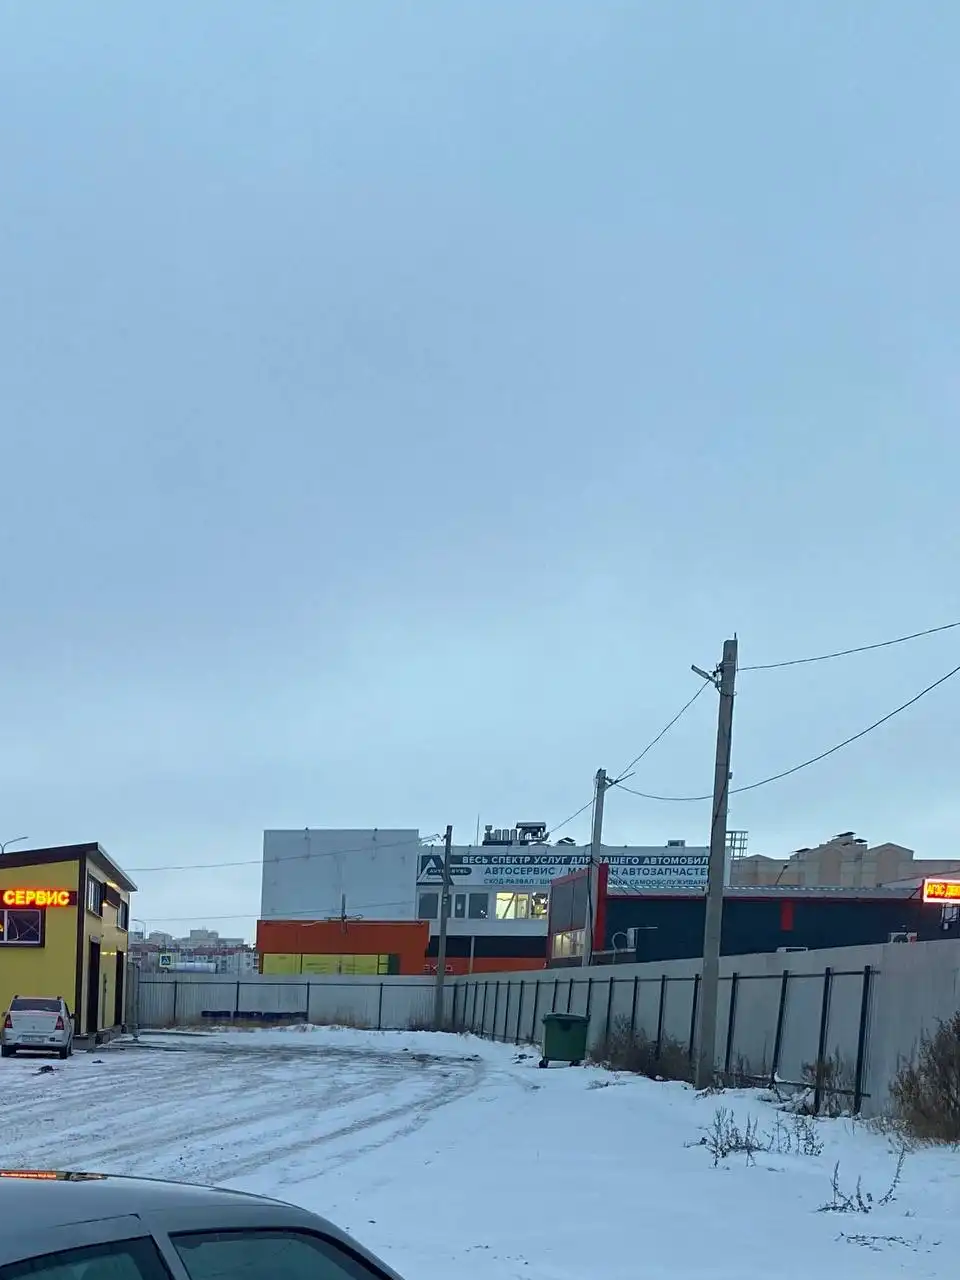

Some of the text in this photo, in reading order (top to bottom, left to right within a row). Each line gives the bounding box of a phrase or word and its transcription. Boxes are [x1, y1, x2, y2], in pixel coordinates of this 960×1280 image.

[462, 856, 488, 864] ВЕСЬ
[491, 856, 531, 864] СПЕКТР
[533, 856, 567, 864] УСЛУГ
[570, 856, 591, 865] ДЛЯ
[642, 857, 709, 865] АВТОМОБИЛ
[484, 867, 555, 876] АВТОСЕРВИС
[622, 867, 707, 876] АВТОЗАПЧАСТЕ
[2, 889, 70, 906] СЕРВИС
